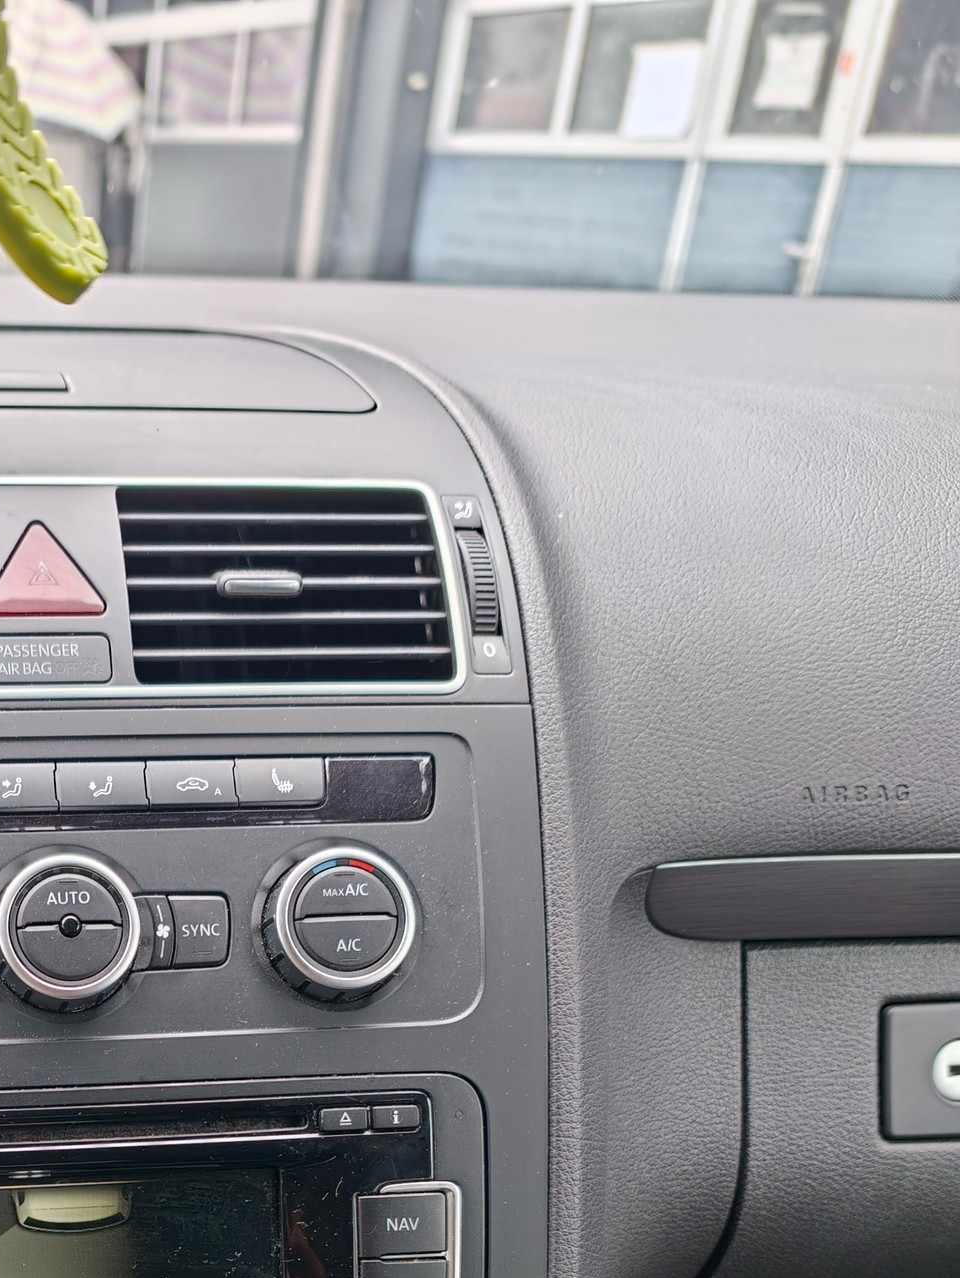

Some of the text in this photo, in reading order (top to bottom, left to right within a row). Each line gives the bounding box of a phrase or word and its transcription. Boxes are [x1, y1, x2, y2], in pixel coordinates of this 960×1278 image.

[22, 662, 52, 675] BAG
[800, 783, 910, 803] AIRBAG
[344, 883, 369, 897] A/C
[47, 890, 90, 905] AUTO
[181, 923, 220, 937] SYNC
[336, 938, 362, 952] A/C
[386, 1217, 419, 1232] NAV
